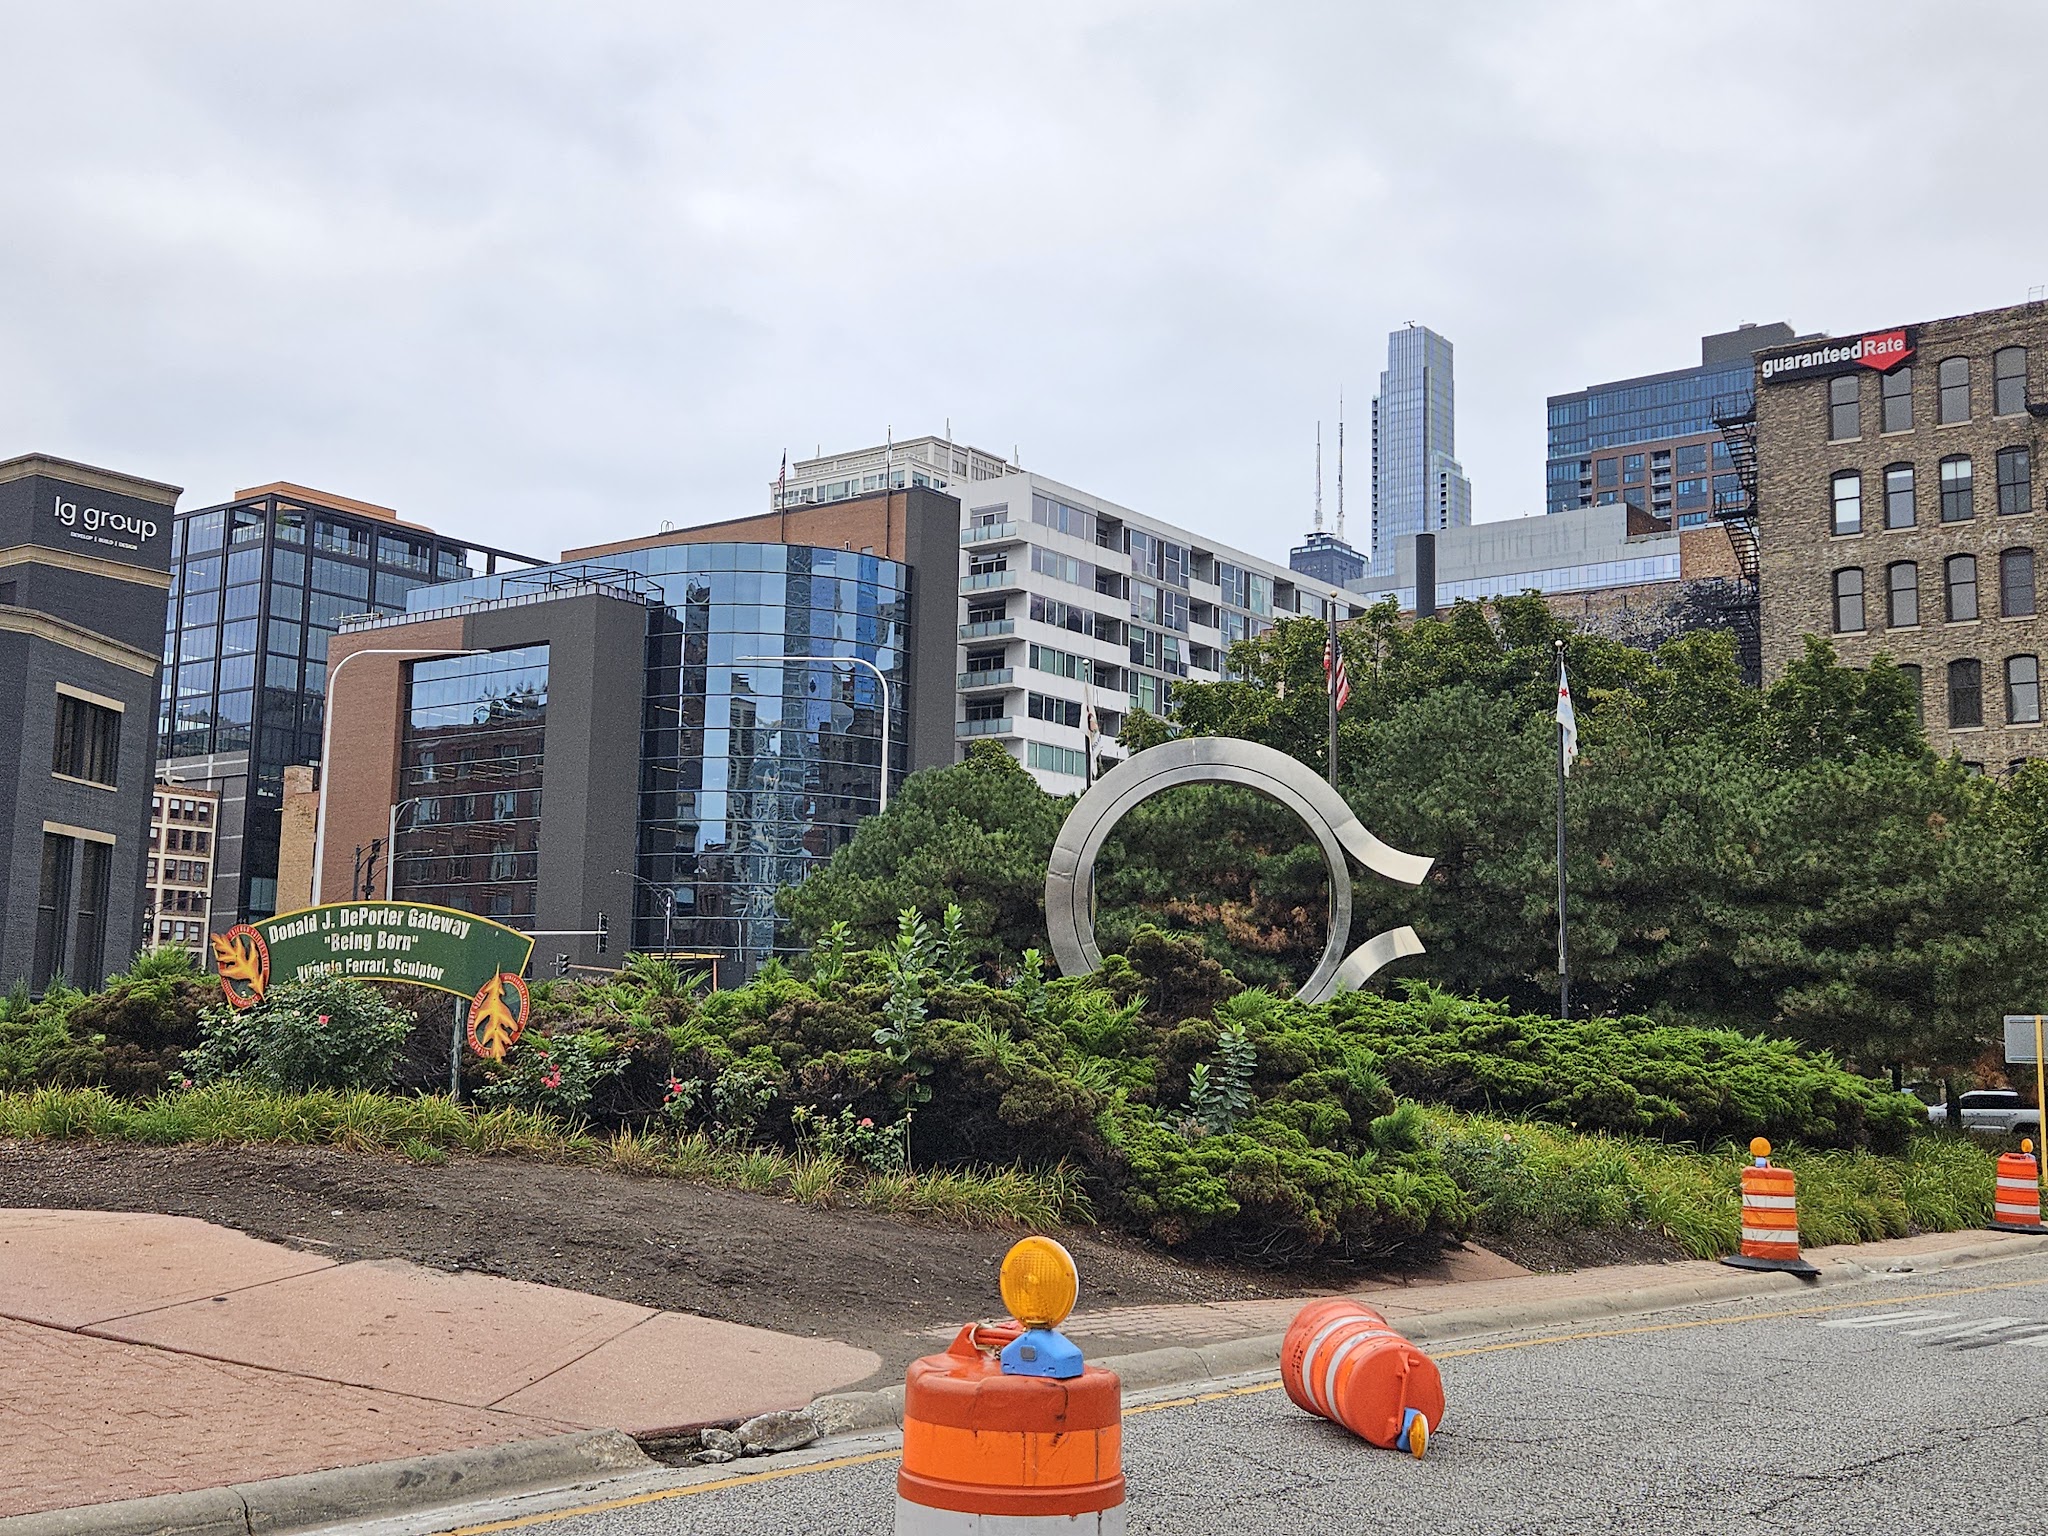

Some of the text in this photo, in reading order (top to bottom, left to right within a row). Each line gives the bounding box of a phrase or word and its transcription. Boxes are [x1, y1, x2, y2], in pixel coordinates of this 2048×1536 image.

[83, 508, 157, 541] group
[268, 907, 471, 944] Donald J. DePorter Gateway
[324, 930, 419, 952] "Being Born"
[345, 957, 389, 975] Ferrari,
[393, 959, 445, 981] Sculptor
